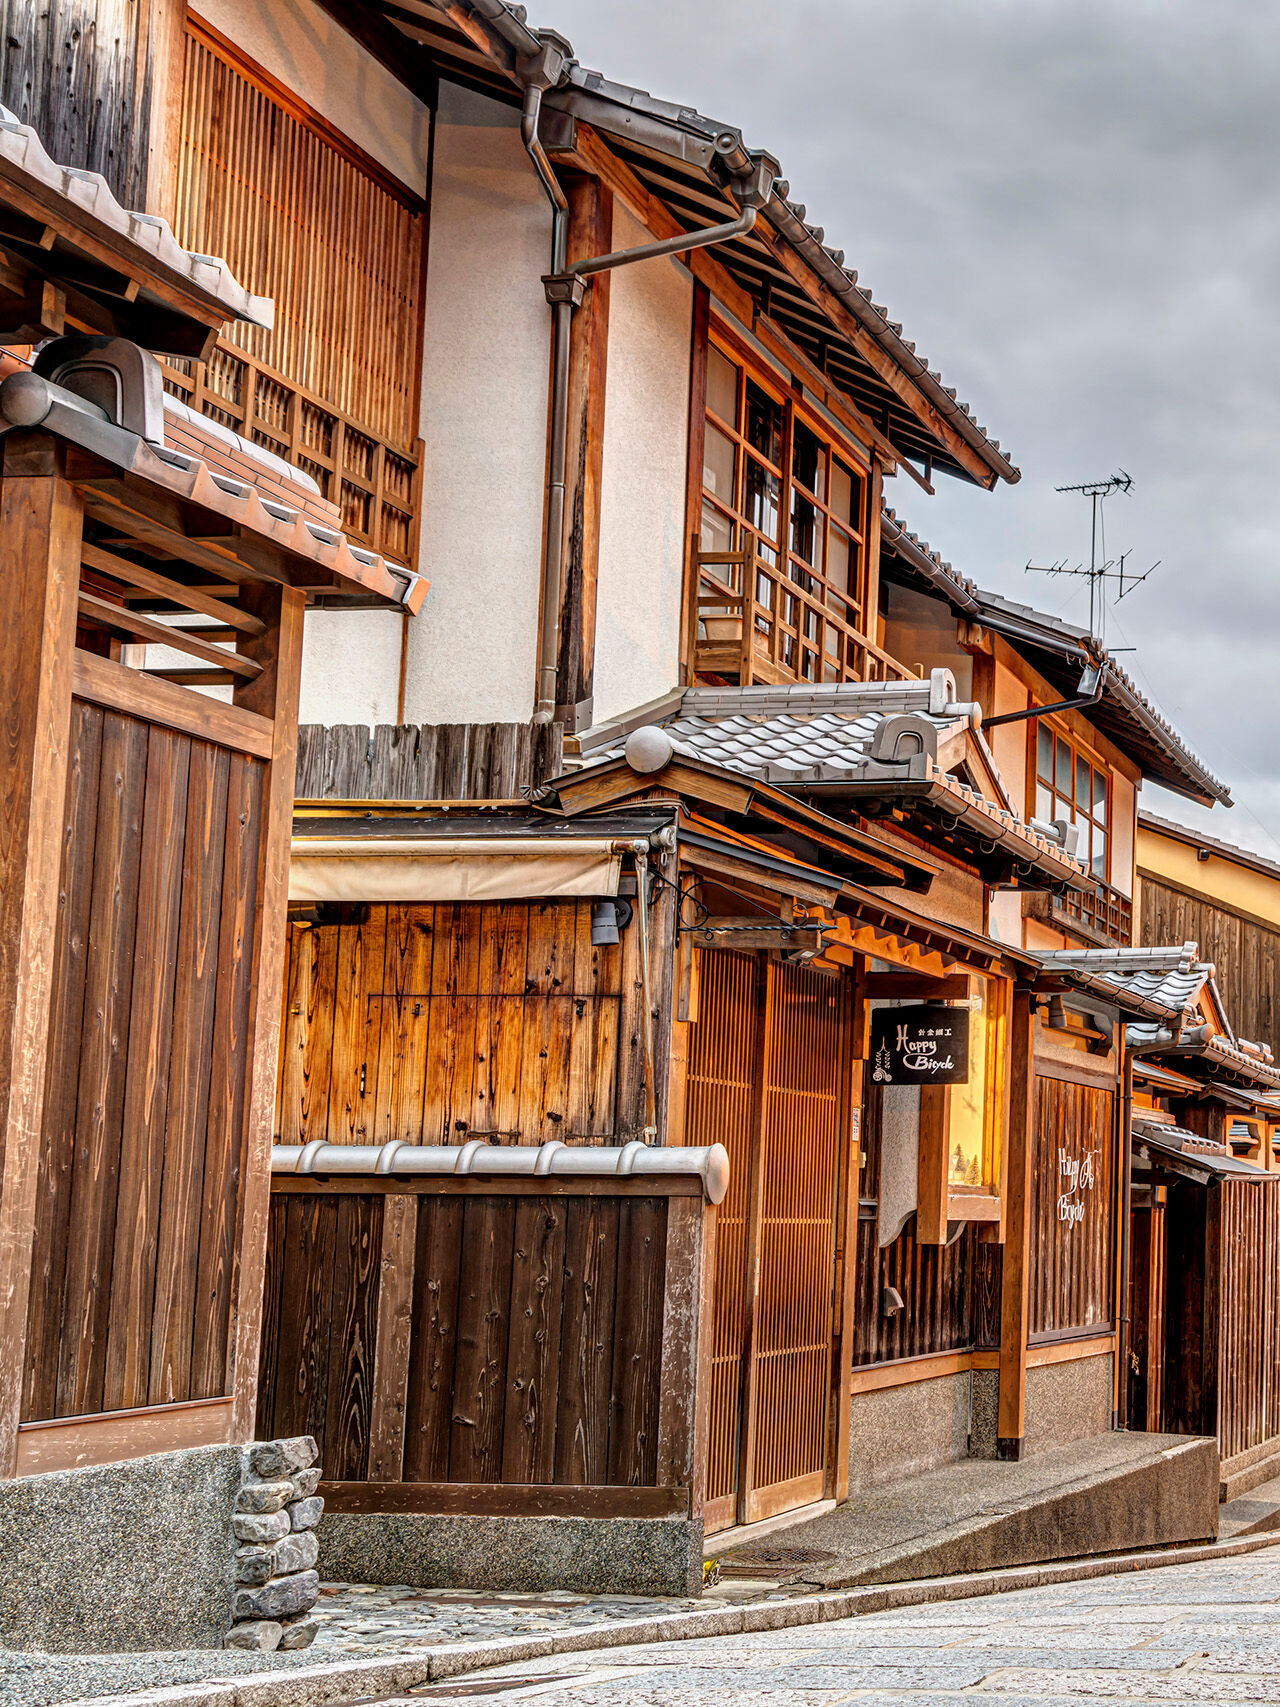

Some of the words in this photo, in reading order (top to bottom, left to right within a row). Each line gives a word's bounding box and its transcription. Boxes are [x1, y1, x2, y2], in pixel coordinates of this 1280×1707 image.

[896, 1024, 937, 1055] Happy
[903, 1055, 954, 1074] Bicycle
[1058, 1147, 1080, 1193] Happy
[1057, 1195, 1085, 1229] Bicycle
